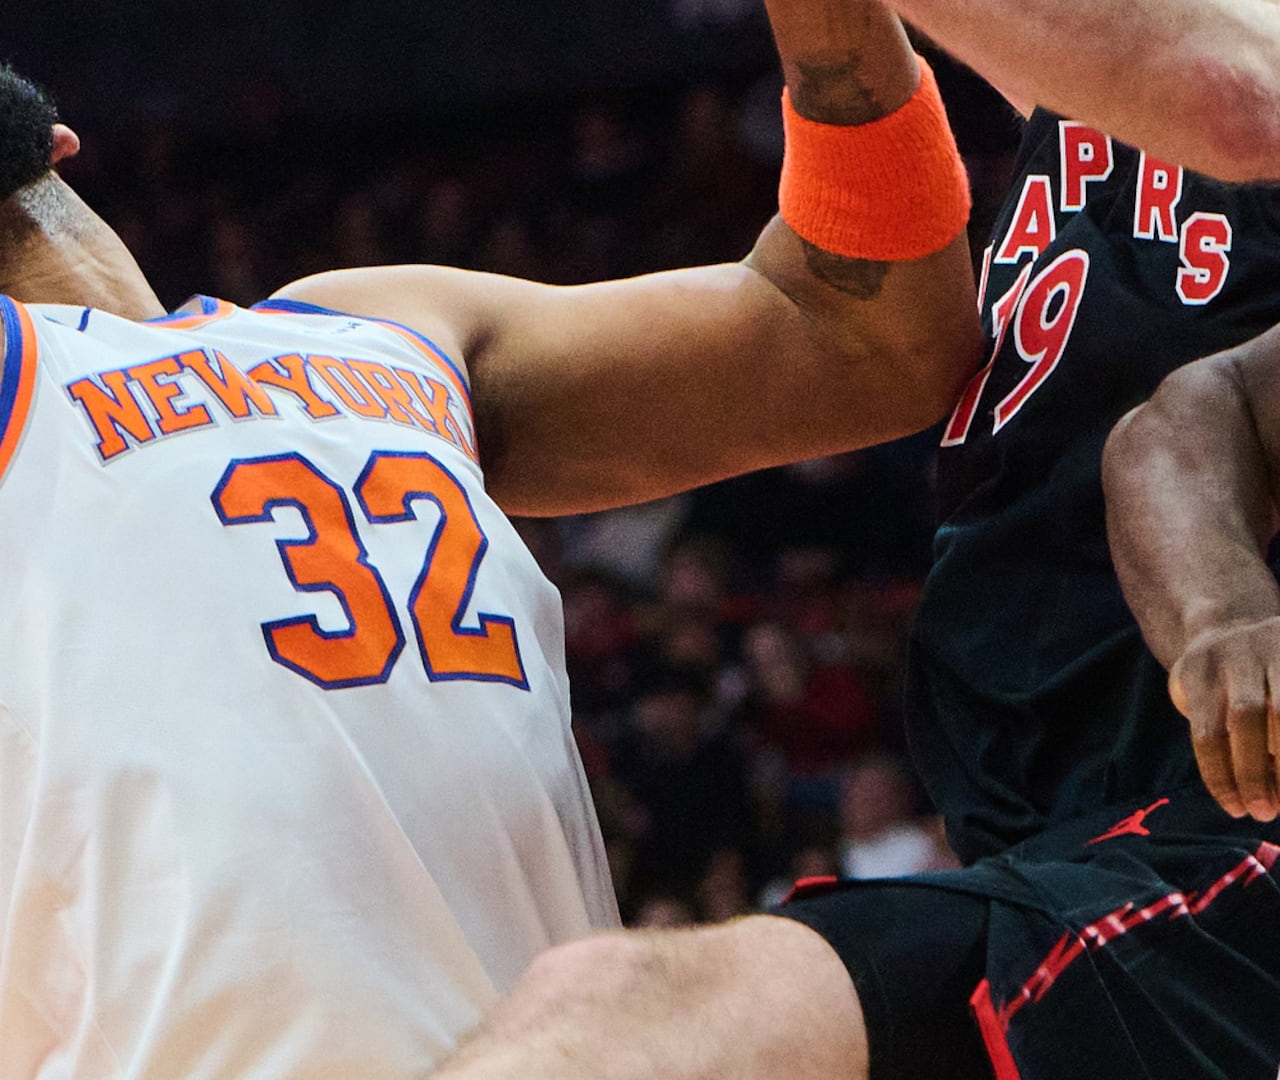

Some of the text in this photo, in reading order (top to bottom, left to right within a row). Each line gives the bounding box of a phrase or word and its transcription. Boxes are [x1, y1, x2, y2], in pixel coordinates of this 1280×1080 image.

[67, 345, 481, 470] NEW YORK
[940, 248, 1090, 448] 19
[210, 449, 530, 692] 32
